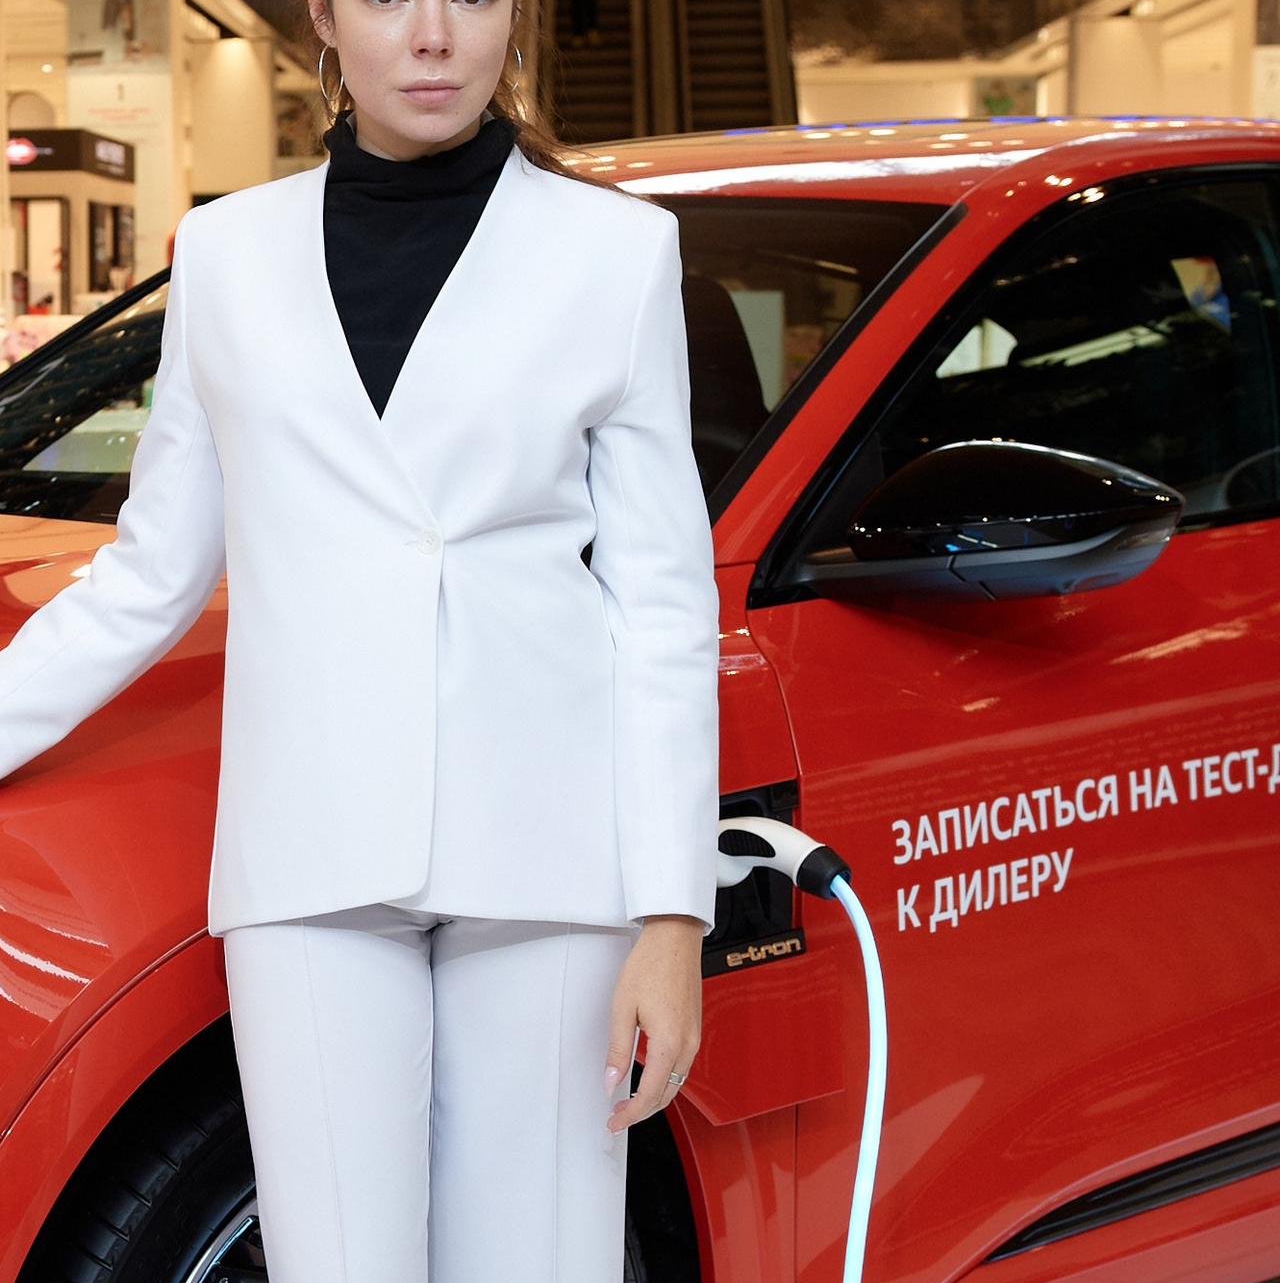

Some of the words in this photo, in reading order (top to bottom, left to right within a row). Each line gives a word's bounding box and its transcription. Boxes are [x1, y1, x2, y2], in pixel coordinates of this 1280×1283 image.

[891, 774, 1119, 865] ЗАПИСАТЬСЯ
[1128, 765, 1178, 812] НА
[896, 884, 922, 932] К
[928, 848, 1074, 934] ДИЛЕРУ
[726, 937, 802, 968] e-tron
